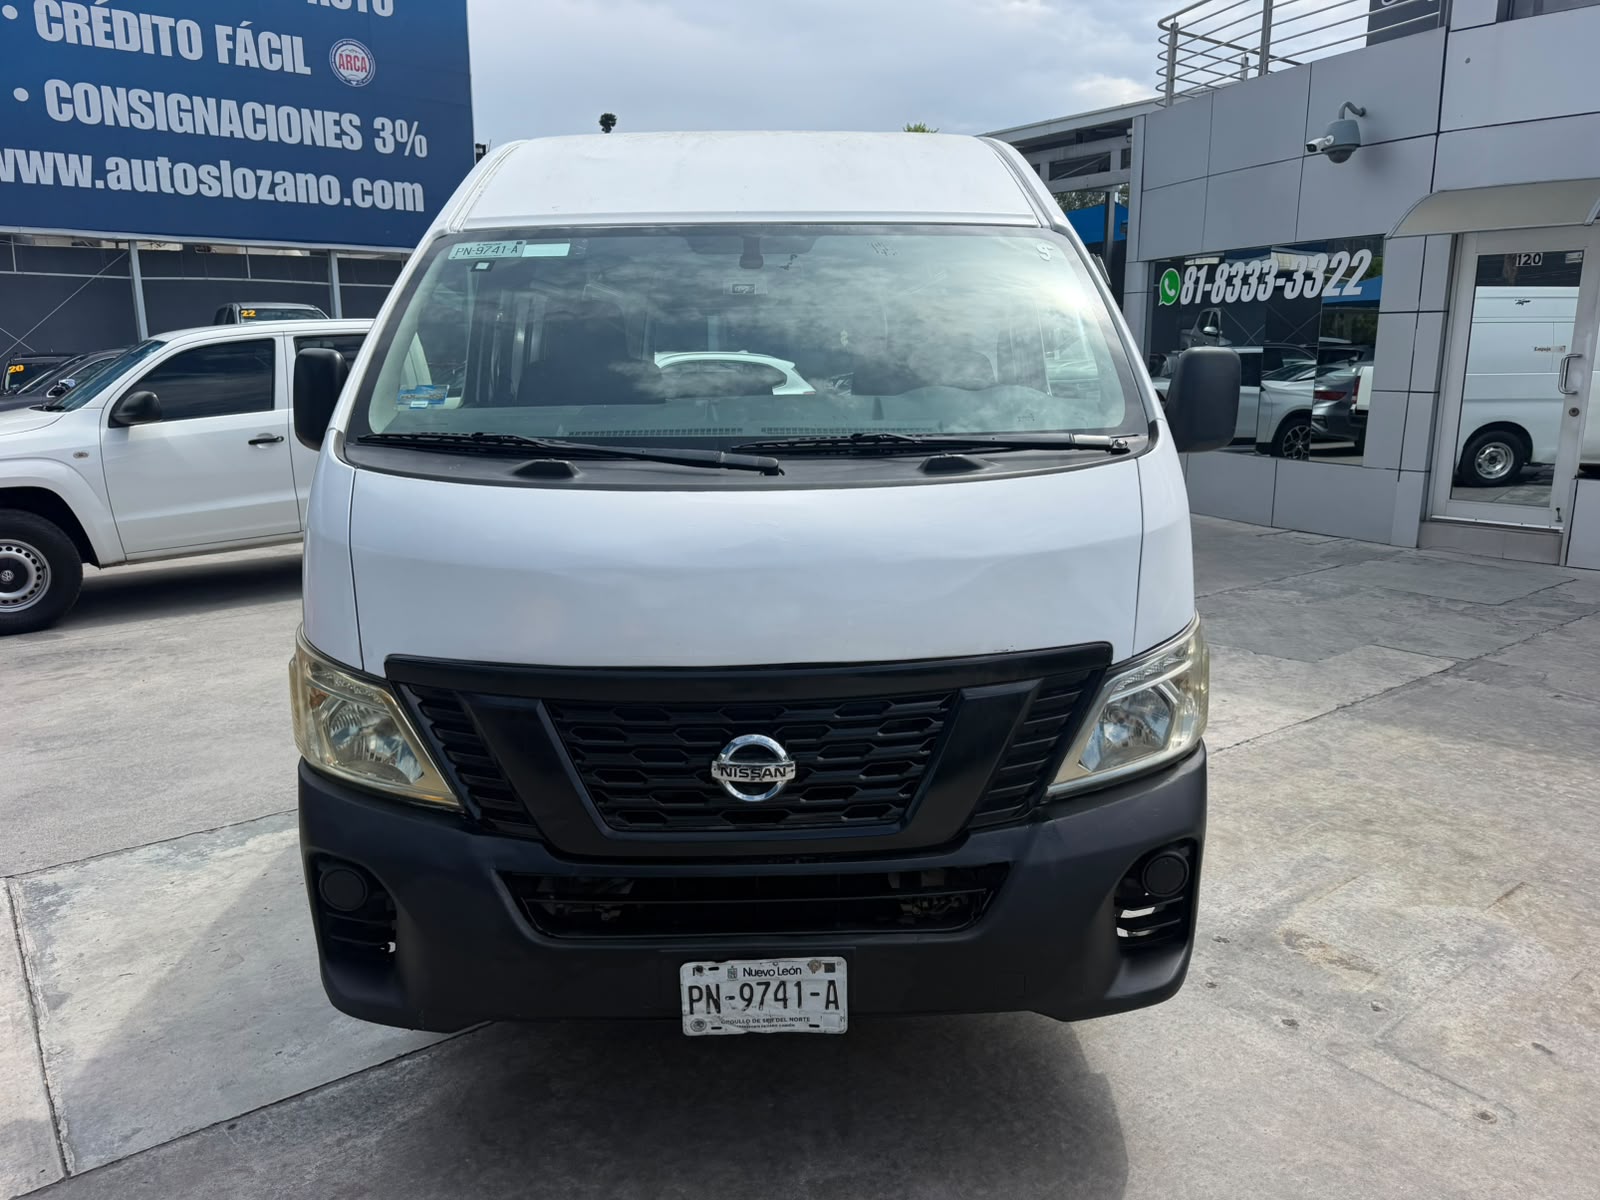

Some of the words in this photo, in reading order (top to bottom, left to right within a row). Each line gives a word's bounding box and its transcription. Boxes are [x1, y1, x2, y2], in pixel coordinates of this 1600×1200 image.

[35, 0, 203, 61] CRÉDITO
[215, 20, 311, 76] FÁCIL
[338, 53, 367, 73] ARCA
[44, 79, 362, 152] CONSIGNACIONES
[373, 117, 428, 158] 3%
[455, 245, 518, 256] PN-9741-A
[1517, 253, 1542, 266] 120
[1181, 249, 1372, 306] 81-8333-3322
[240, 309, 256, 317] 22
[8, 365, 24, 373] 20
[720, 767, 787, 779] NISSAN
[743, 967, 776, 977] Nuevo
[777, 966, 802, 976] León
[688, 980, 840, 1015] PN-9741-A
